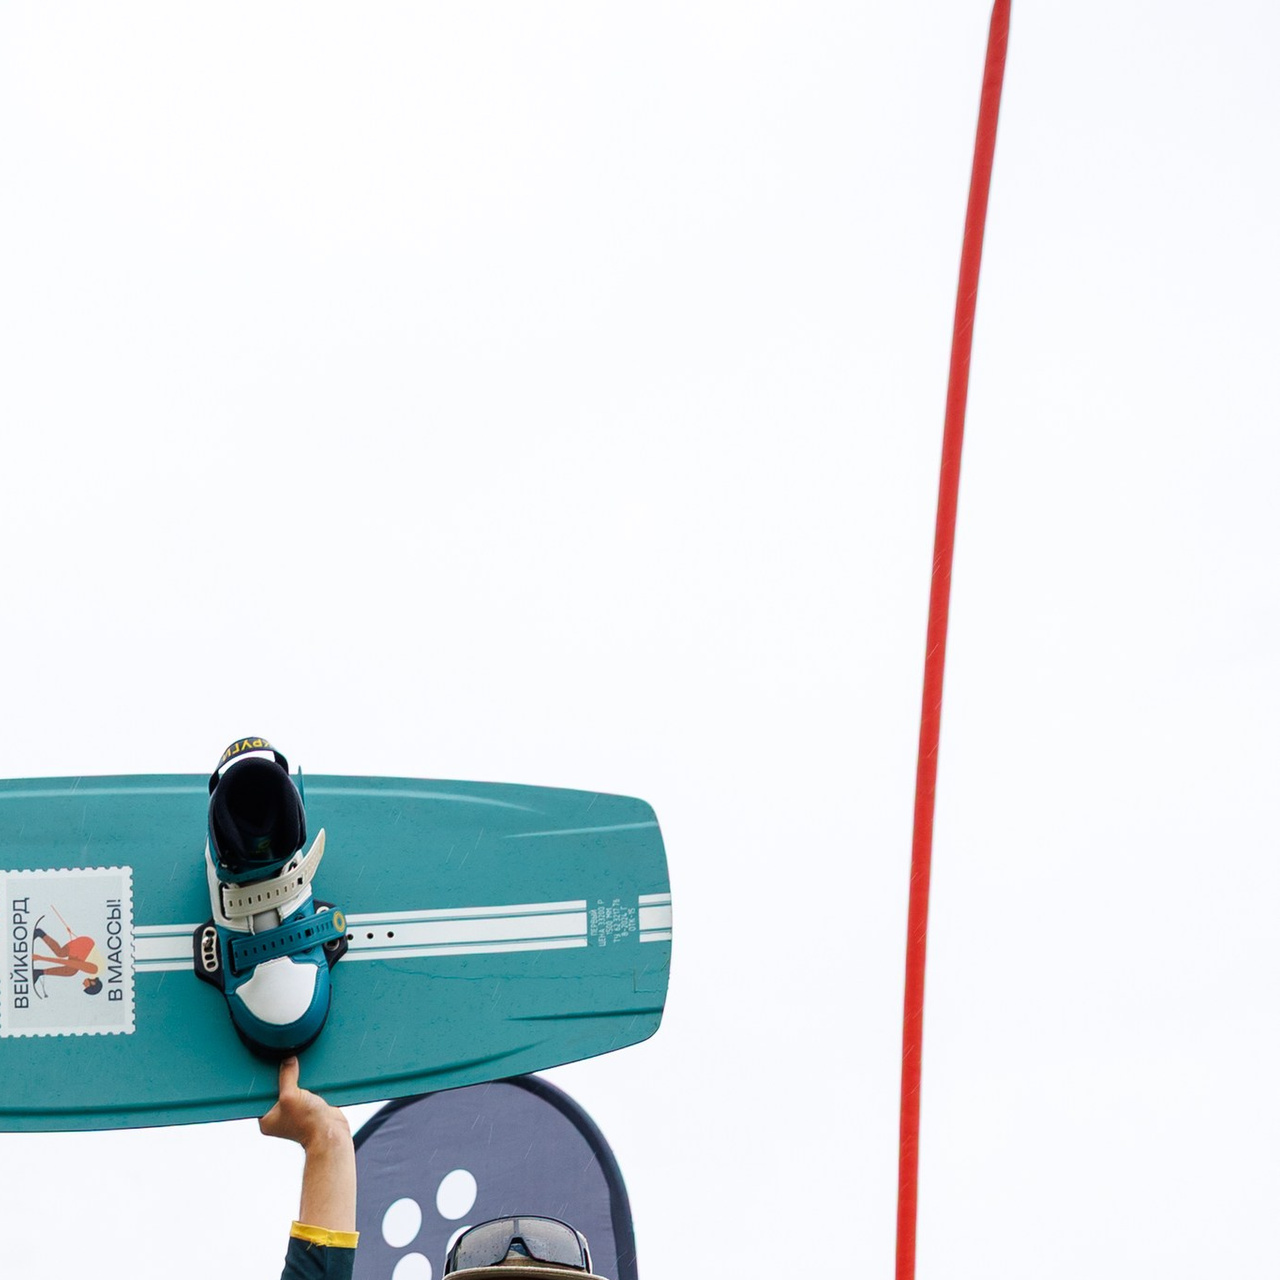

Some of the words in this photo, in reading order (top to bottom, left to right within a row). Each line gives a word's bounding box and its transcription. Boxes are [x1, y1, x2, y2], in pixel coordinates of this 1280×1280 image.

[10, 897, 30, 1009] ВЕЙКБОРД
[106, 899, 122, 984] МАССЫ!
[598, 928, 606, 947] ЦЕНА
[107, 988, 123, 1001] В
